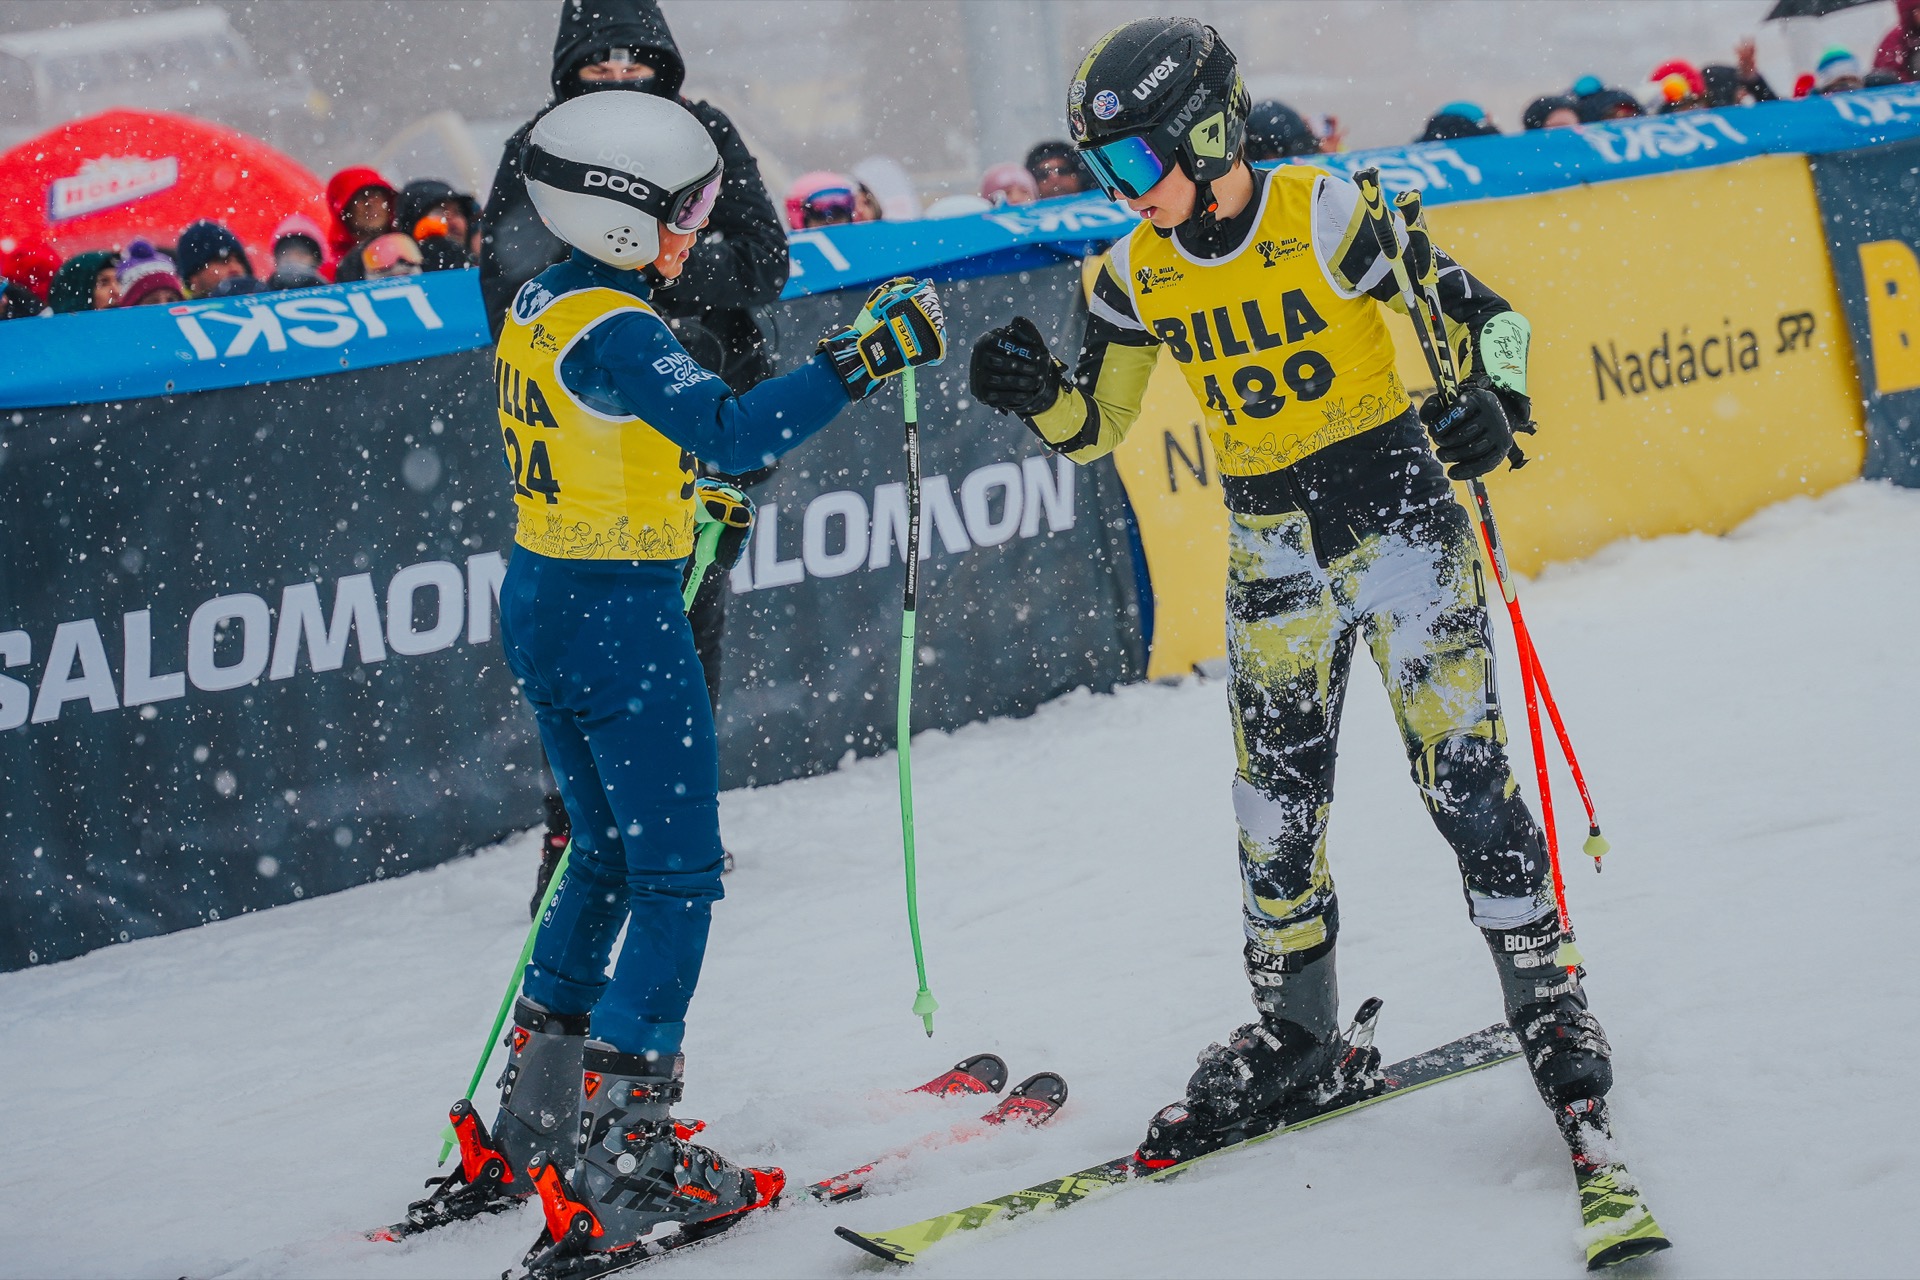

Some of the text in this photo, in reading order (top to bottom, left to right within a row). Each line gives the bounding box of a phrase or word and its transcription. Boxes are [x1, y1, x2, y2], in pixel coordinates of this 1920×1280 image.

[1132, 55, 1180, 100] uvex
[1167, 83, 1212, 138] uvex
[176, 285, 444, 361] LISKI
[896, 320, 916, 354] LEVEL
[1153, 288, 1329, 364] BILLA
[674, 360, 698, 381] GIA
[997, 339, 1032, 360] LEVEL
[1591, 318, 1760, 401] Nadácia
[670, 371, 713, 394] PURA
[1434, 406, 1466, 433] LEVEL
[908, 550, 917, 595] KOMPERDELL
